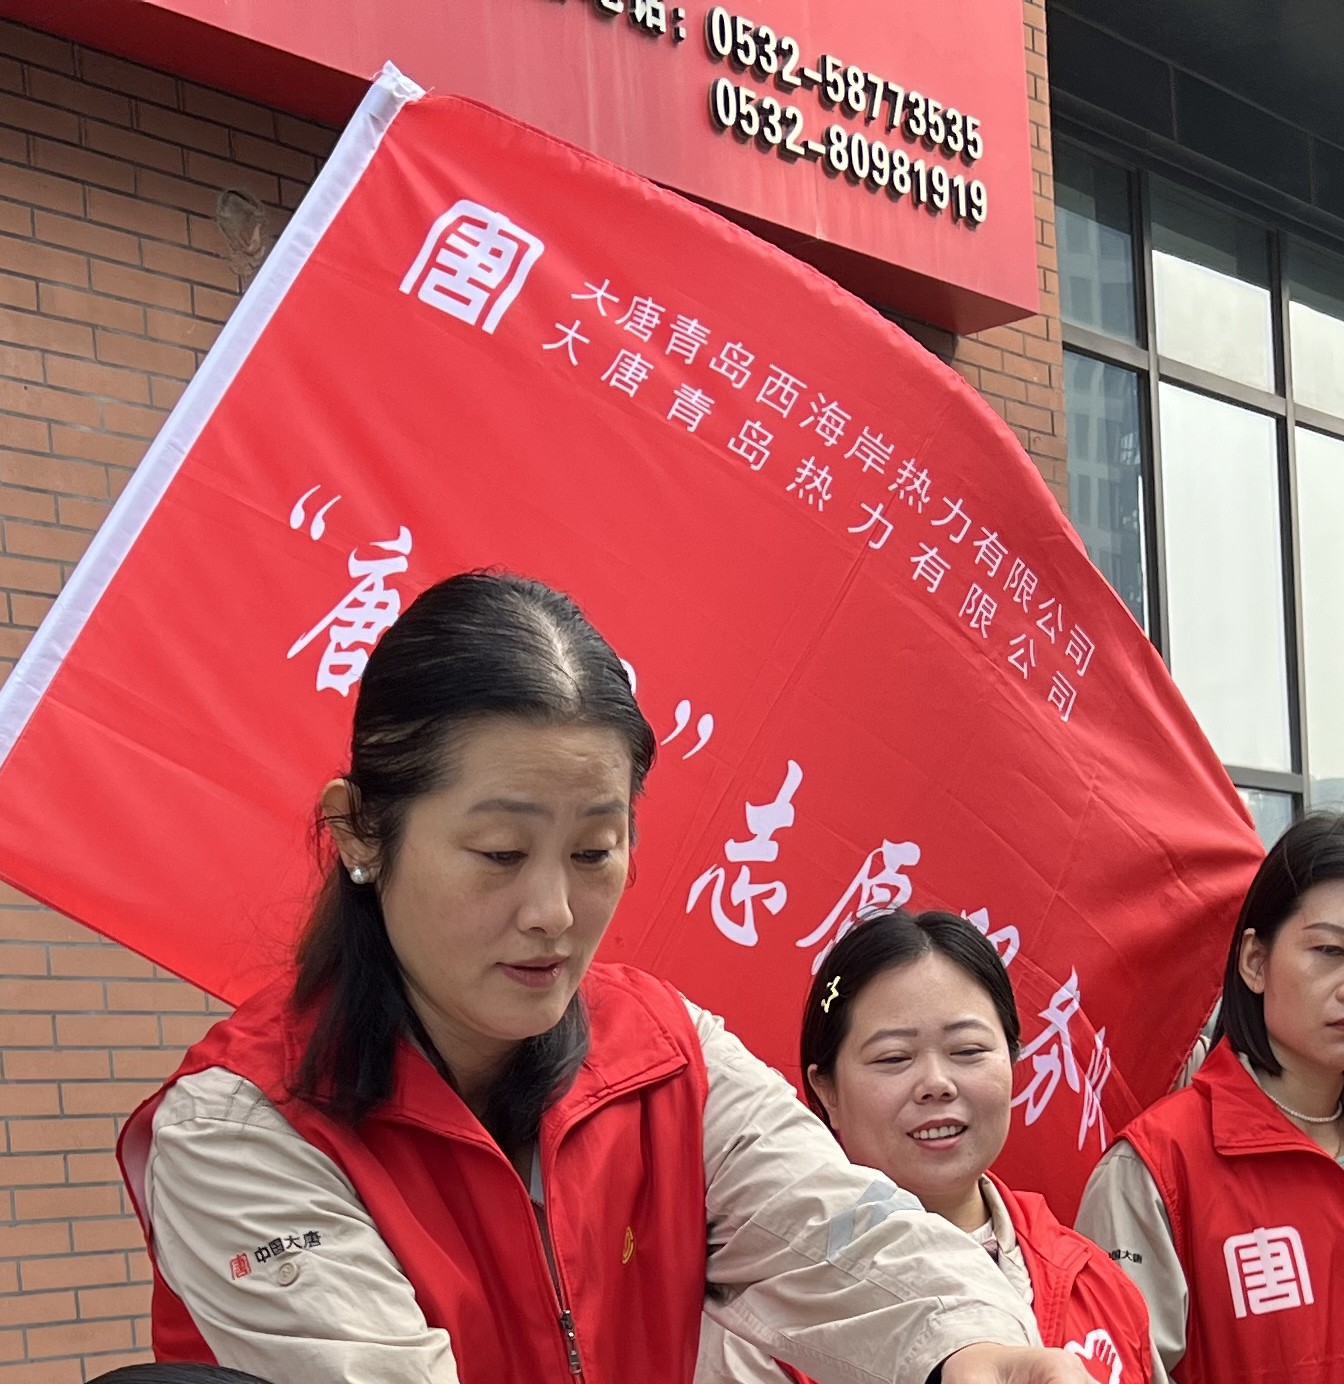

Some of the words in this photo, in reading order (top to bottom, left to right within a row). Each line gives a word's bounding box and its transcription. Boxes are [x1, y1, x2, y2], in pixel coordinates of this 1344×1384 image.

[708, 7, 983, 162] 0532-58773535
[712, 77, 988, 225] 0532-80981919
[541, 319, 1077, 723] 大唐青岛热力有限公司
[570, 278, 1096, 677] 大唐青岛西海岸热力有限公司
[254, 1230, 322, 1263] 中国大唐
